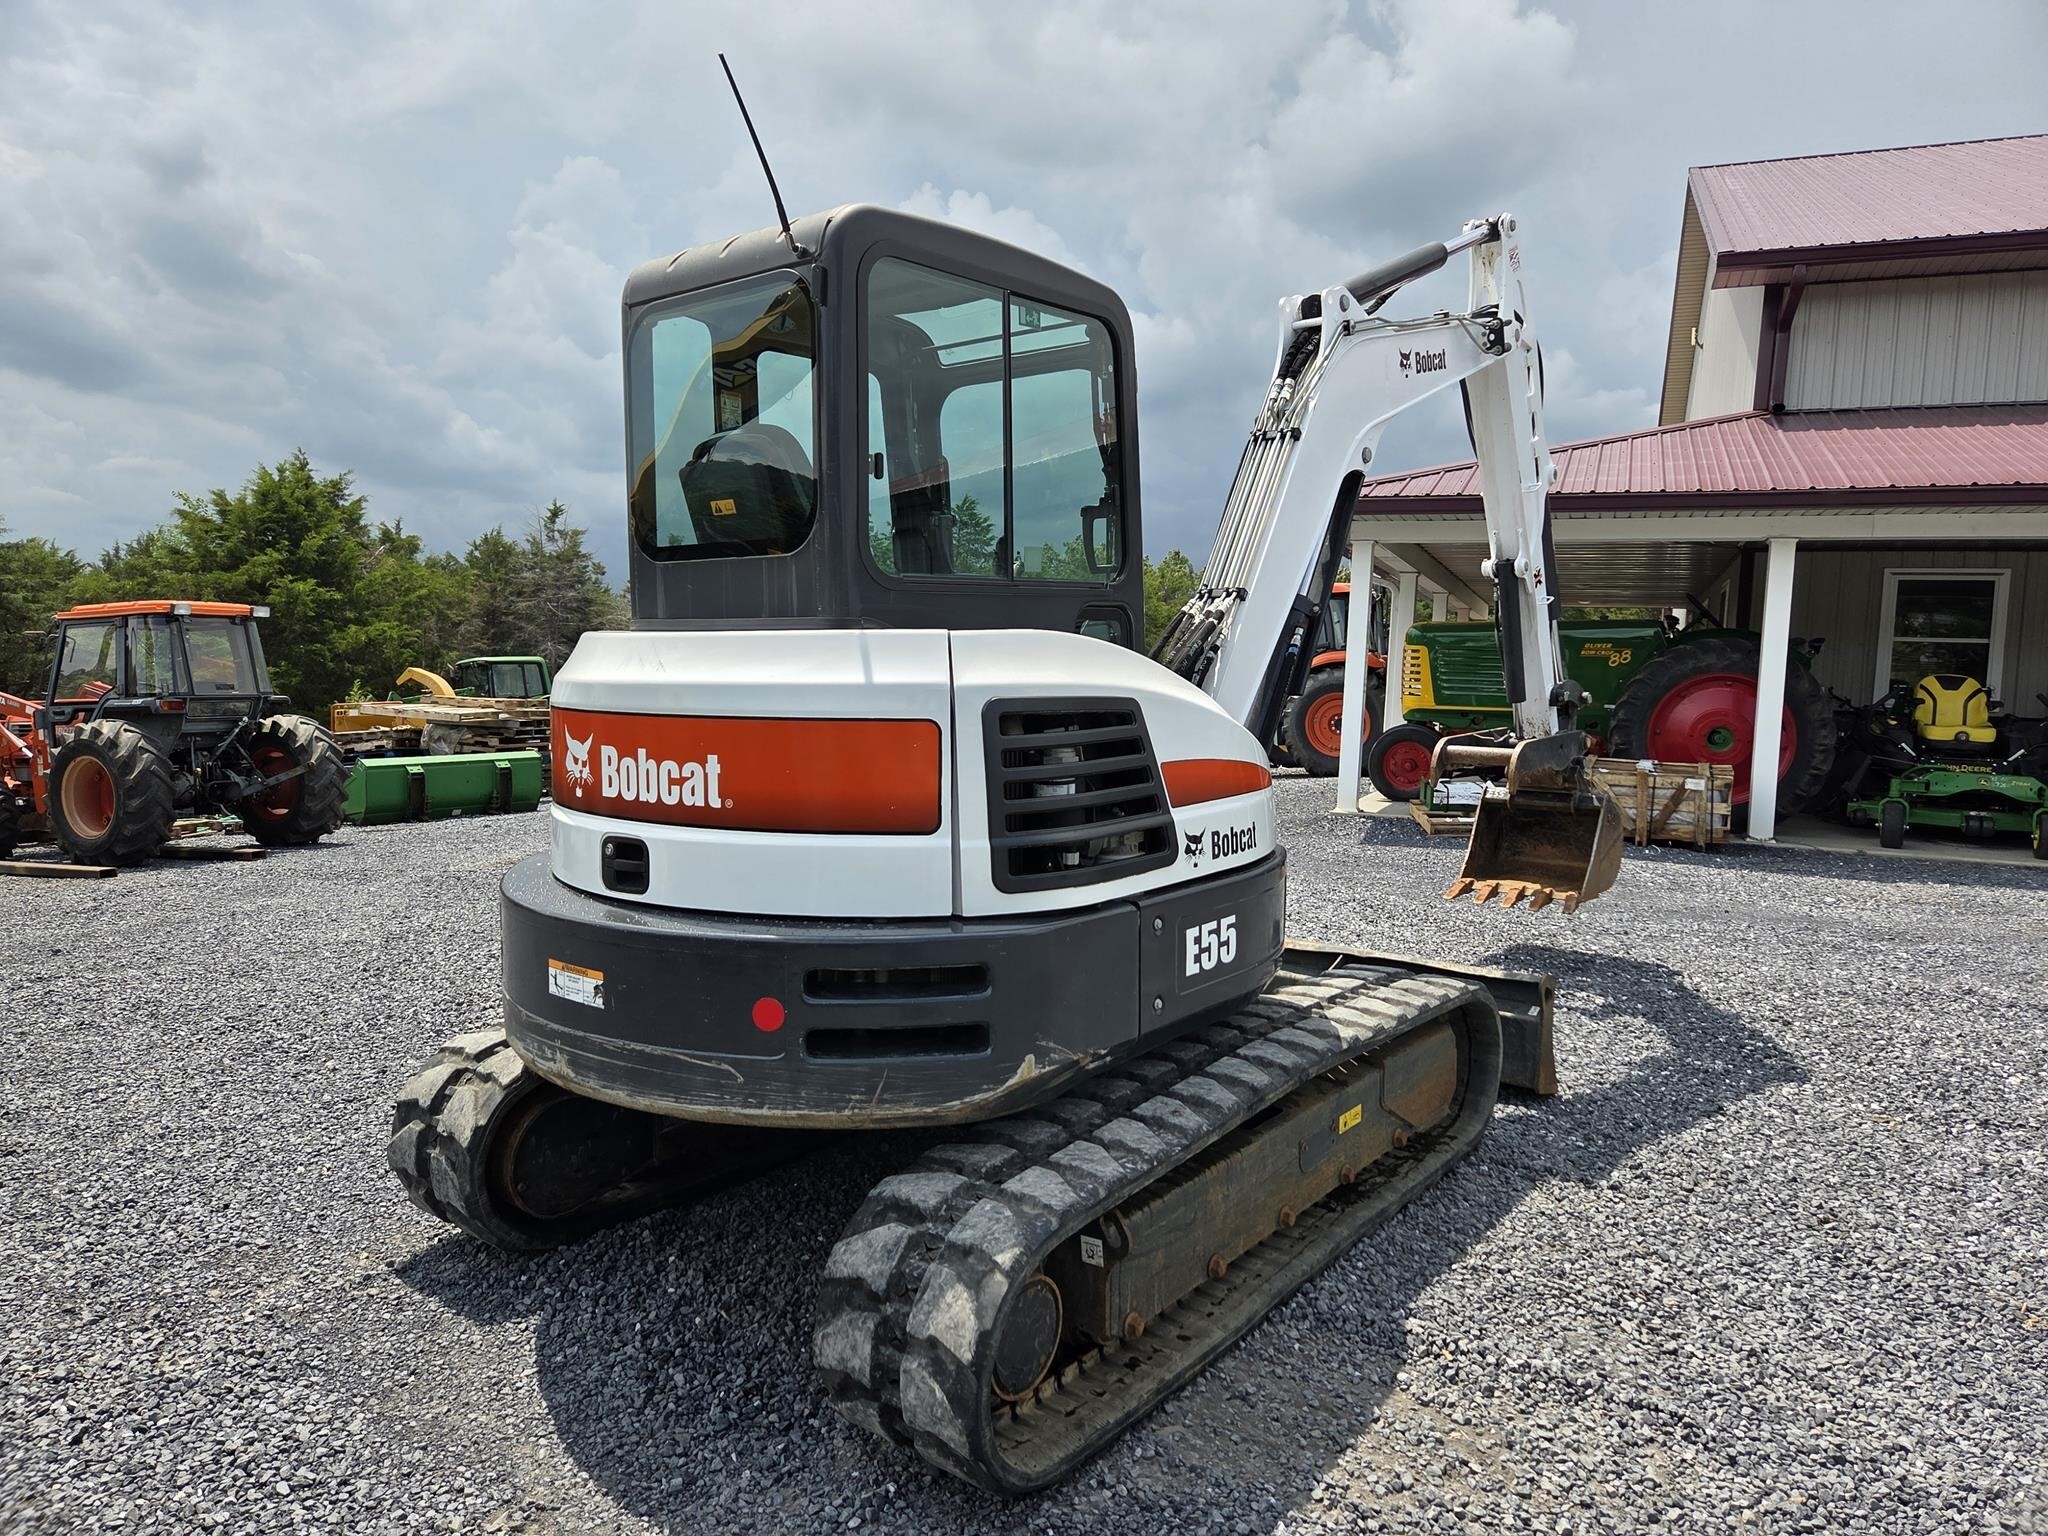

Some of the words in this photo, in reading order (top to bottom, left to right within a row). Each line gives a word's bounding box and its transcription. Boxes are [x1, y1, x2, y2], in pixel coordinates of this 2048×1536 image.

[1415, 348, 1447, 375] Bobcat
[1608, 649, 1632, 667] 88
[601, 744, 722, 808] Bobcat
[1960, 764, 1993, 773] DEERE
[1211, 821, 1258, 861] Bobcat
[1185, 914, 1238, 978] E55
